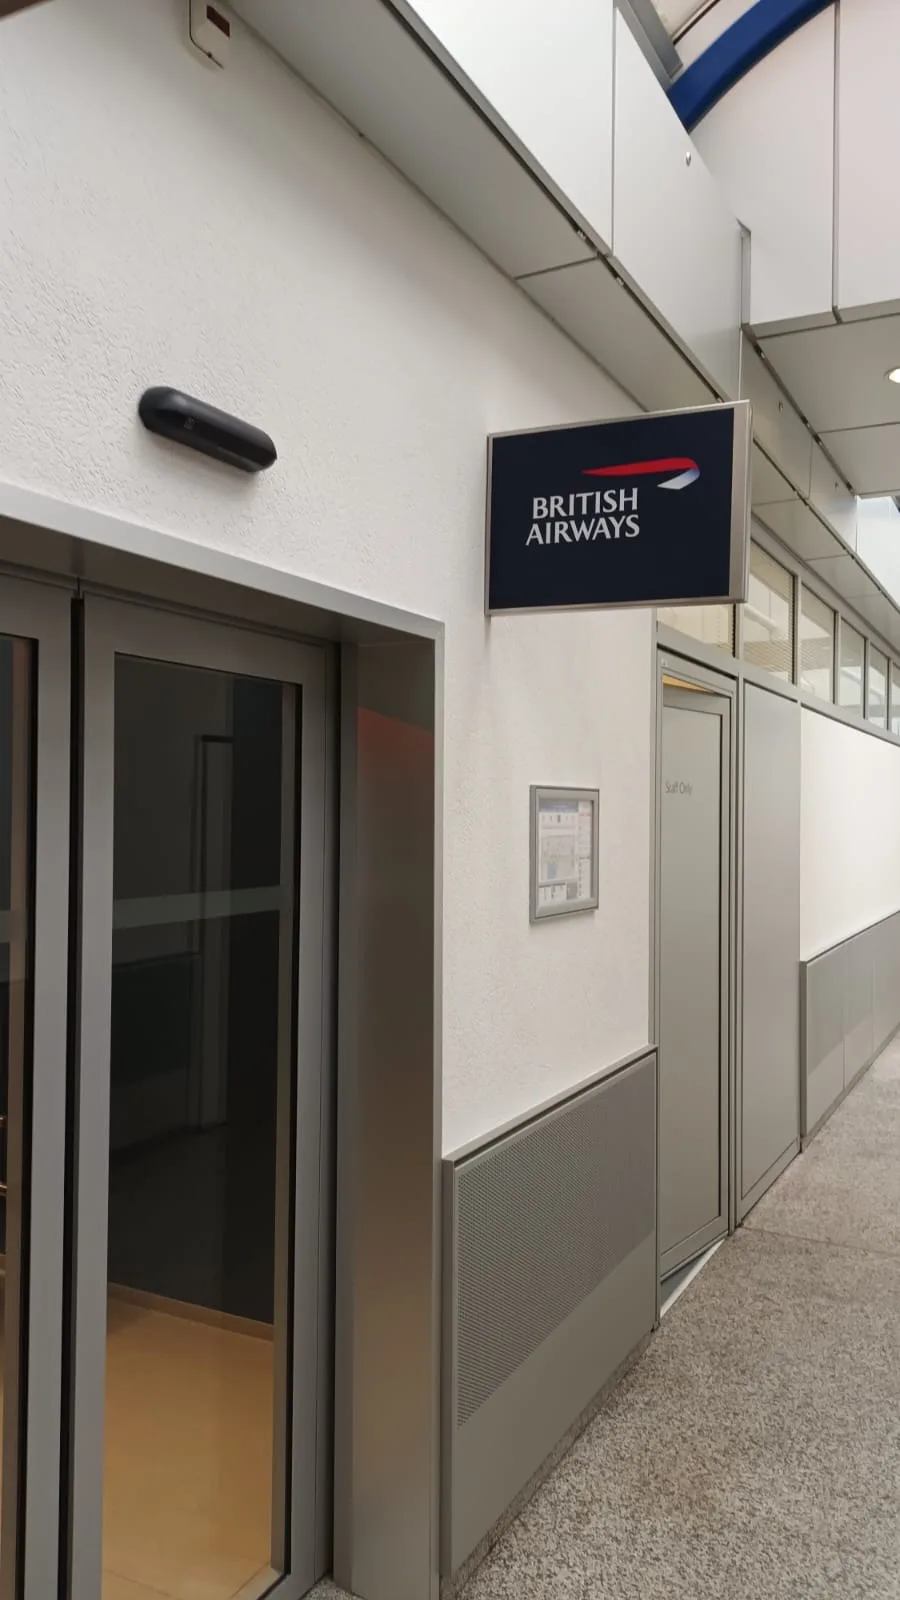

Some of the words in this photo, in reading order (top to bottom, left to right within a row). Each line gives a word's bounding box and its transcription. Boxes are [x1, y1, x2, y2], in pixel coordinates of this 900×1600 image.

[532, 487, 639, 519] BRITISH
[525, 514, 641, 546] AIRWAYS
[665, 780, 679, 794] Staff
[679, 782, 693, 796] Only
